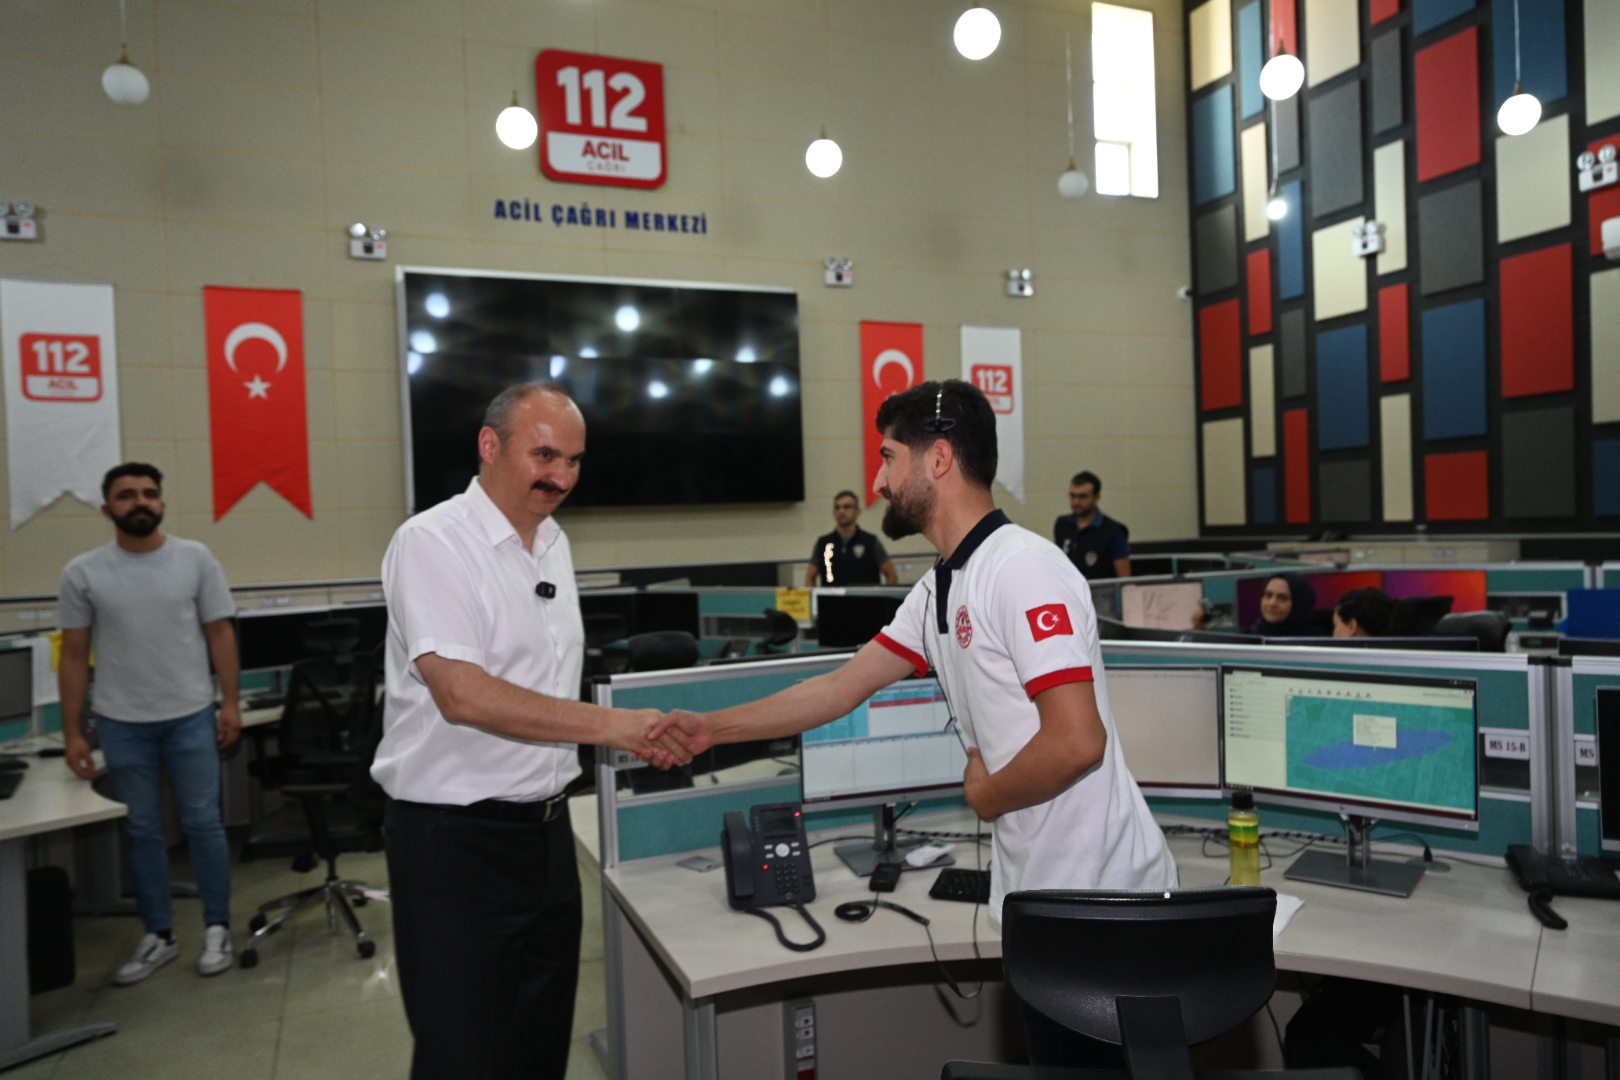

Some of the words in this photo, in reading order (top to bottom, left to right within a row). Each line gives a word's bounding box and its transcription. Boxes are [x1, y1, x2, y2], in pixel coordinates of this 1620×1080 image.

[556, 66, 648, 132] 112
[494, 198, 542, 222] ACİL
[551, 203, 615, 228] ÇAĞRI
[624, 211, 707, 234] MERKEZİ
[32, 340, 91, 373] 112
[977, 369, 1008, 392] 112
[1489, 740, 1503, 751] MS
[1579, 748, 1595, 759] MS
